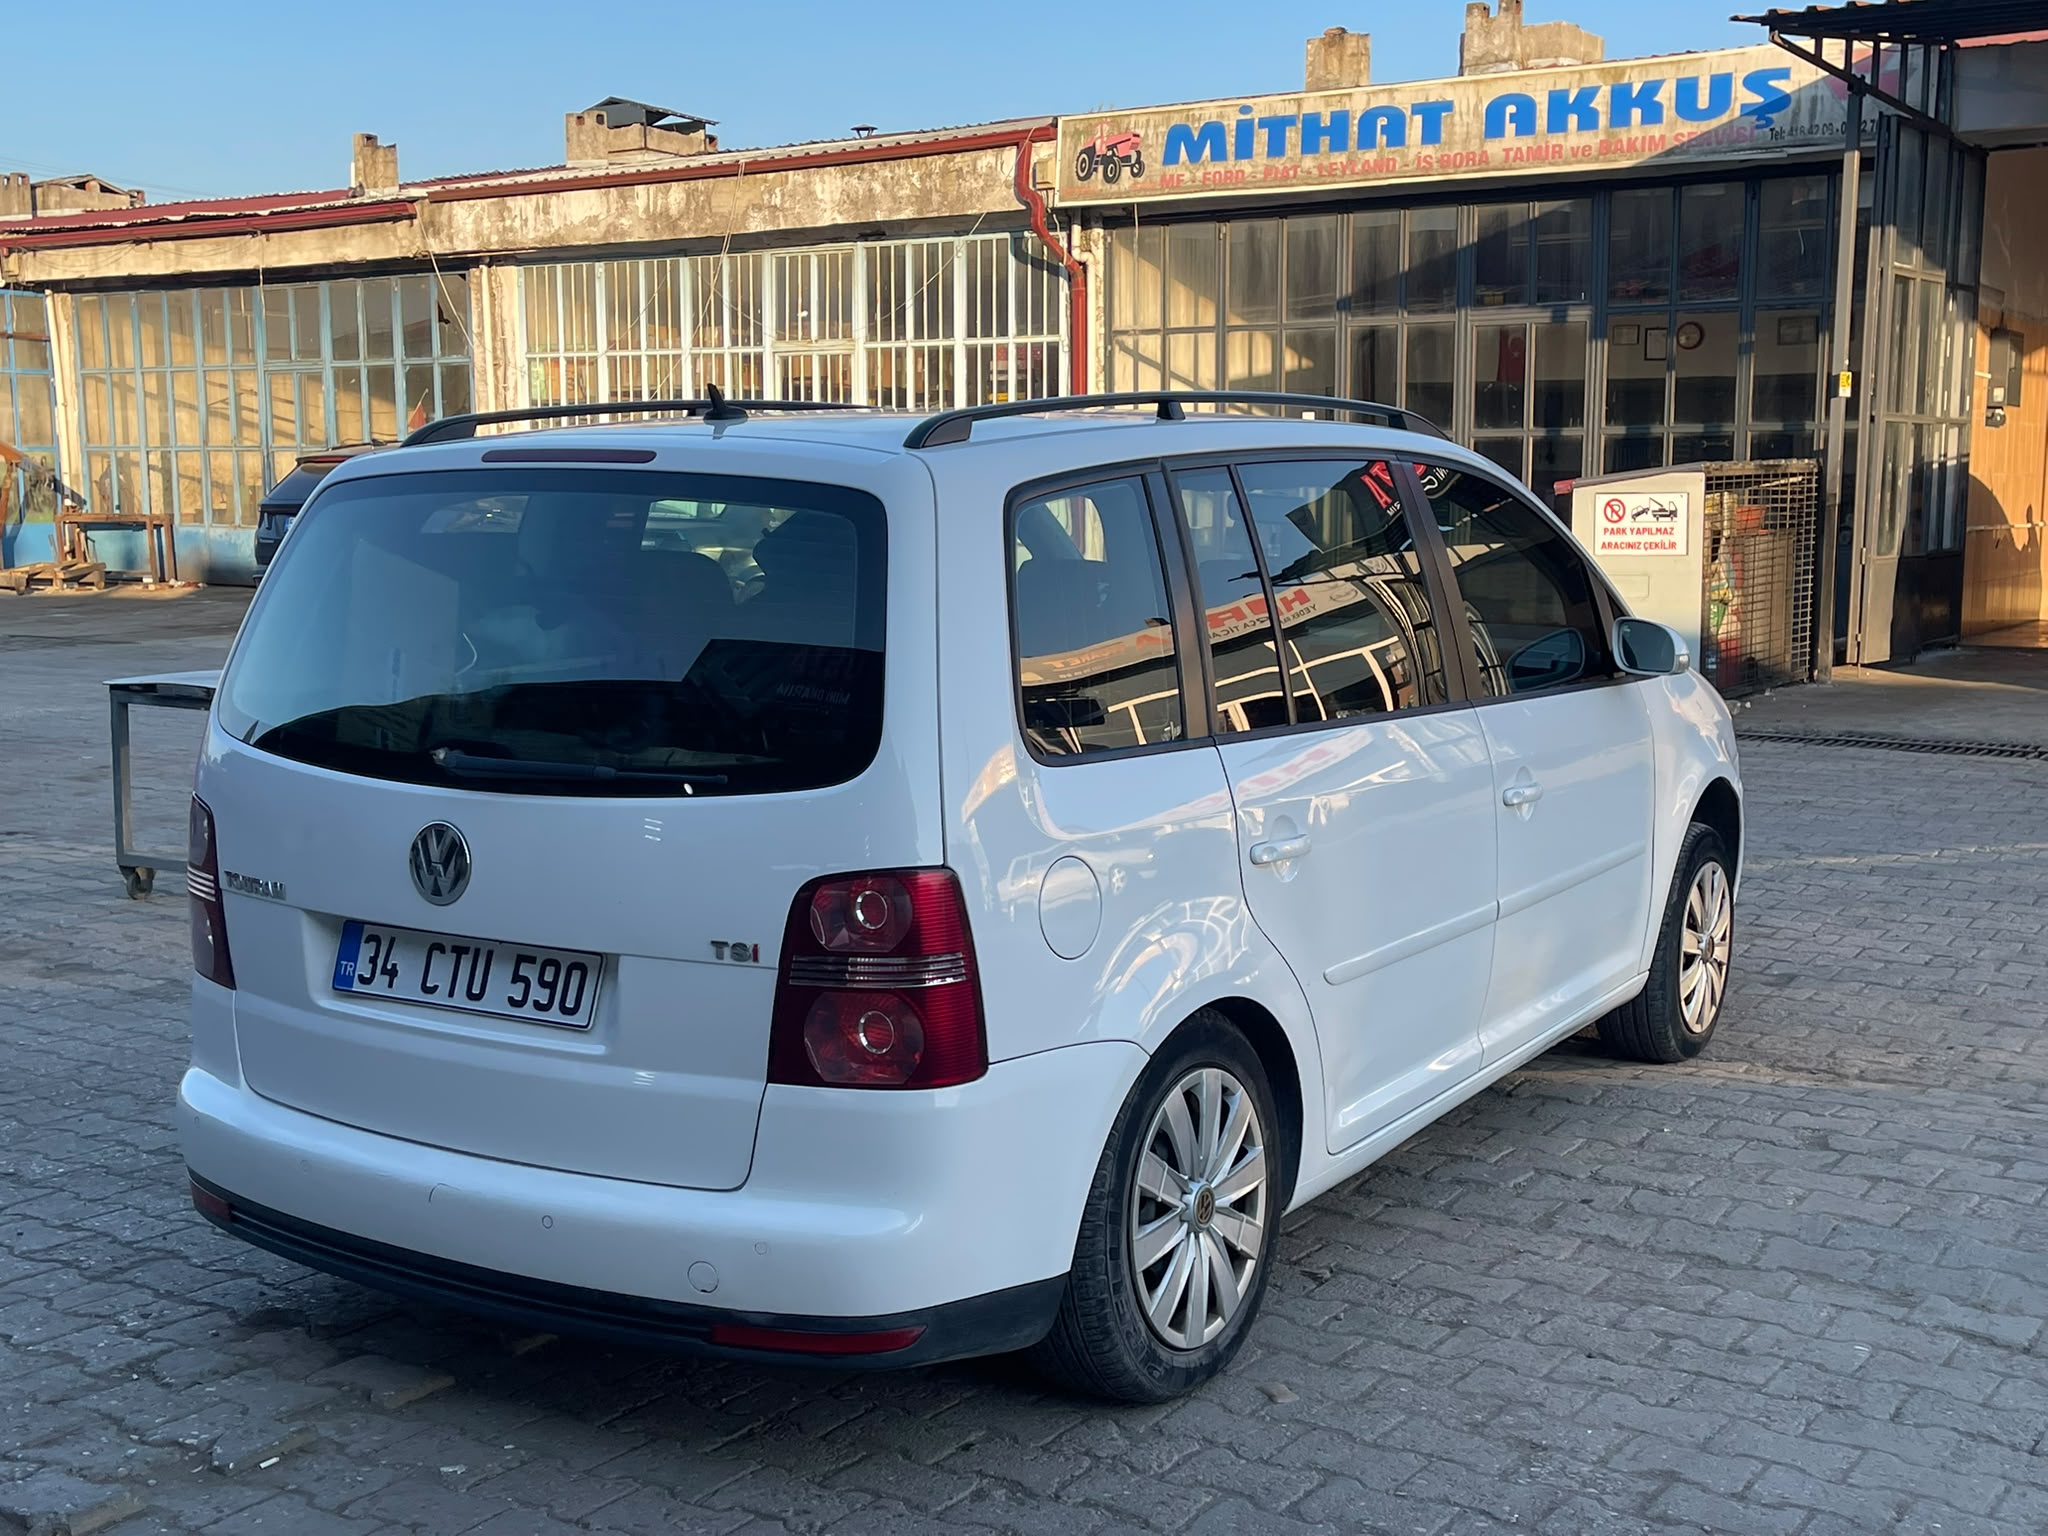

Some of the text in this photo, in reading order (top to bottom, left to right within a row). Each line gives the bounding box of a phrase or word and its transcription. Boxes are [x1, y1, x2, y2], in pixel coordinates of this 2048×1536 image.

[1162, 67, 1791, 166] MİTHAT AKKUŞ
[1202, 169, 1246, 186] FORD
[1317, 157, 1398, 178] LEYLAND
[1502, 140, 1564, 163] TAMİR
[1570, 144, 1593, 158] ve
[1599, 133, 1667, 156] BAKIM
[1601, 539, 1677, 551] ARACINIZ ÇEKİLİR
[1603, 527, 1675, 536] PARK YAPILMAZ
[340, 961, 355, 977] TR
[357, 933, 589, 1016] 34 CTU 590
